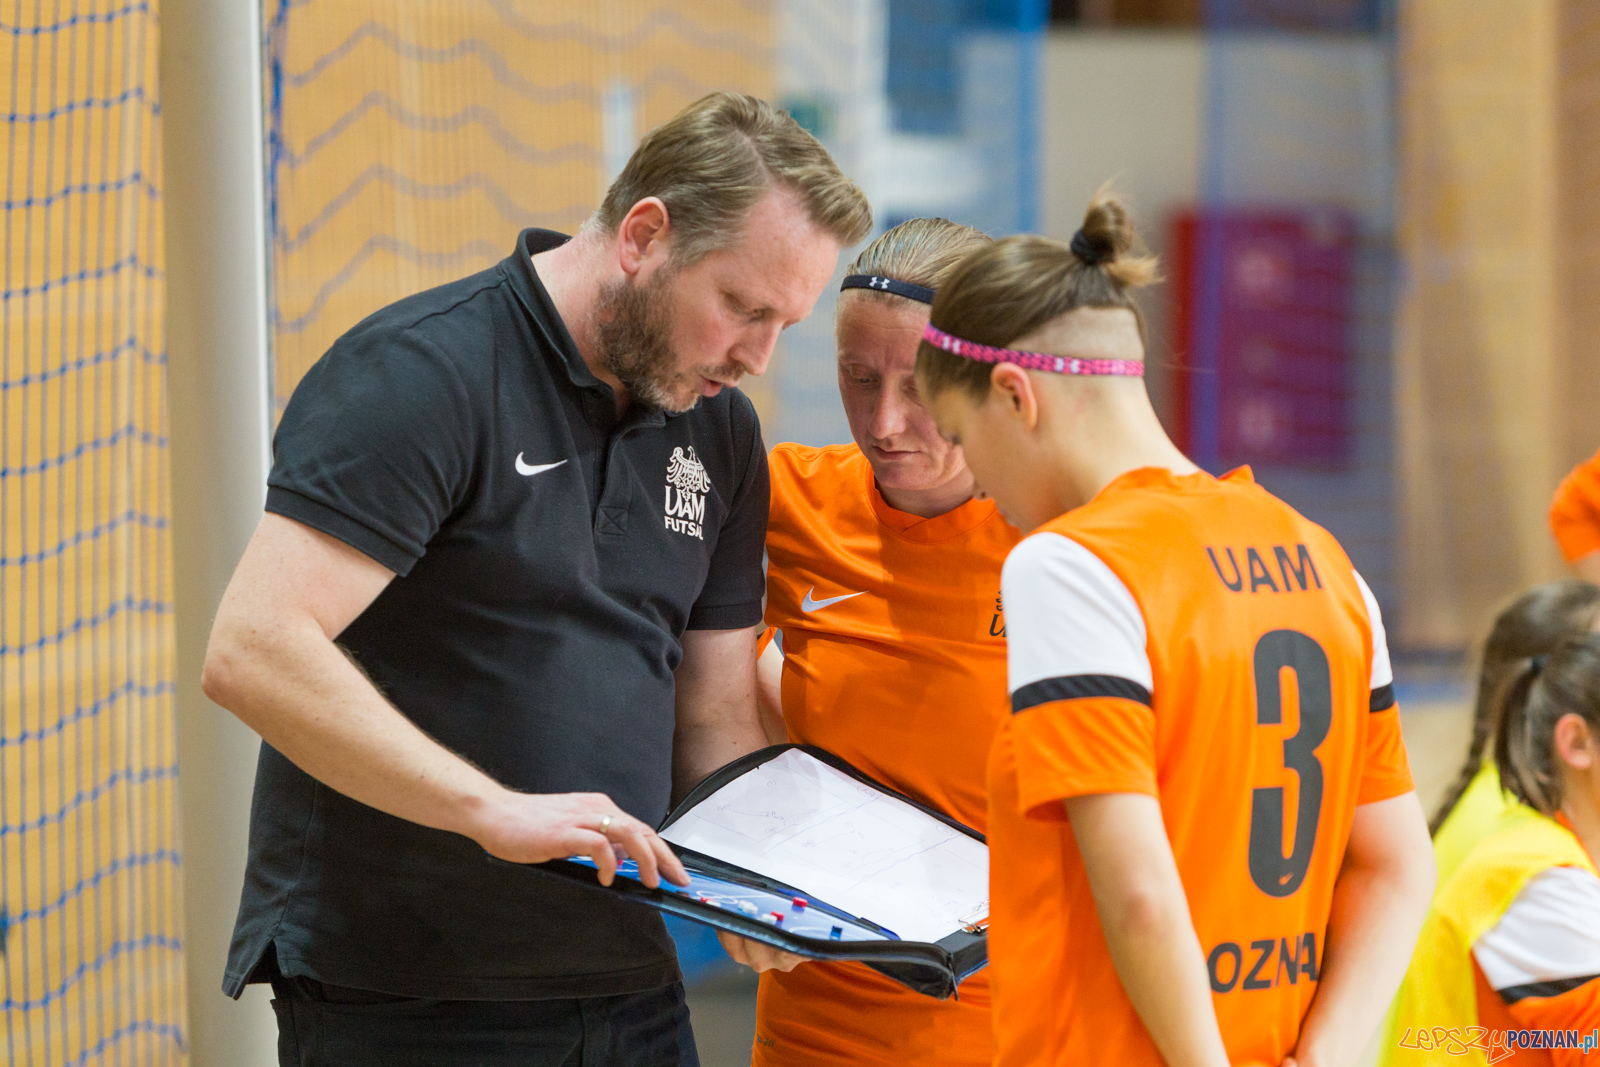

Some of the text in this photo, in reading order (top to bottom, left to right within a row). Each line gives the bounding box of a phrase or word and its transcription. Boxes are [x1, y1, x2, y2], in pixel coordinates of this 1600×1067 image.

[664, 485, 705, 525] UAM
[1206, 544, 1322, 593] UAM
[1248, 629, 1332, 898] 3
[1207, 932, 1318, 994] OZNA
